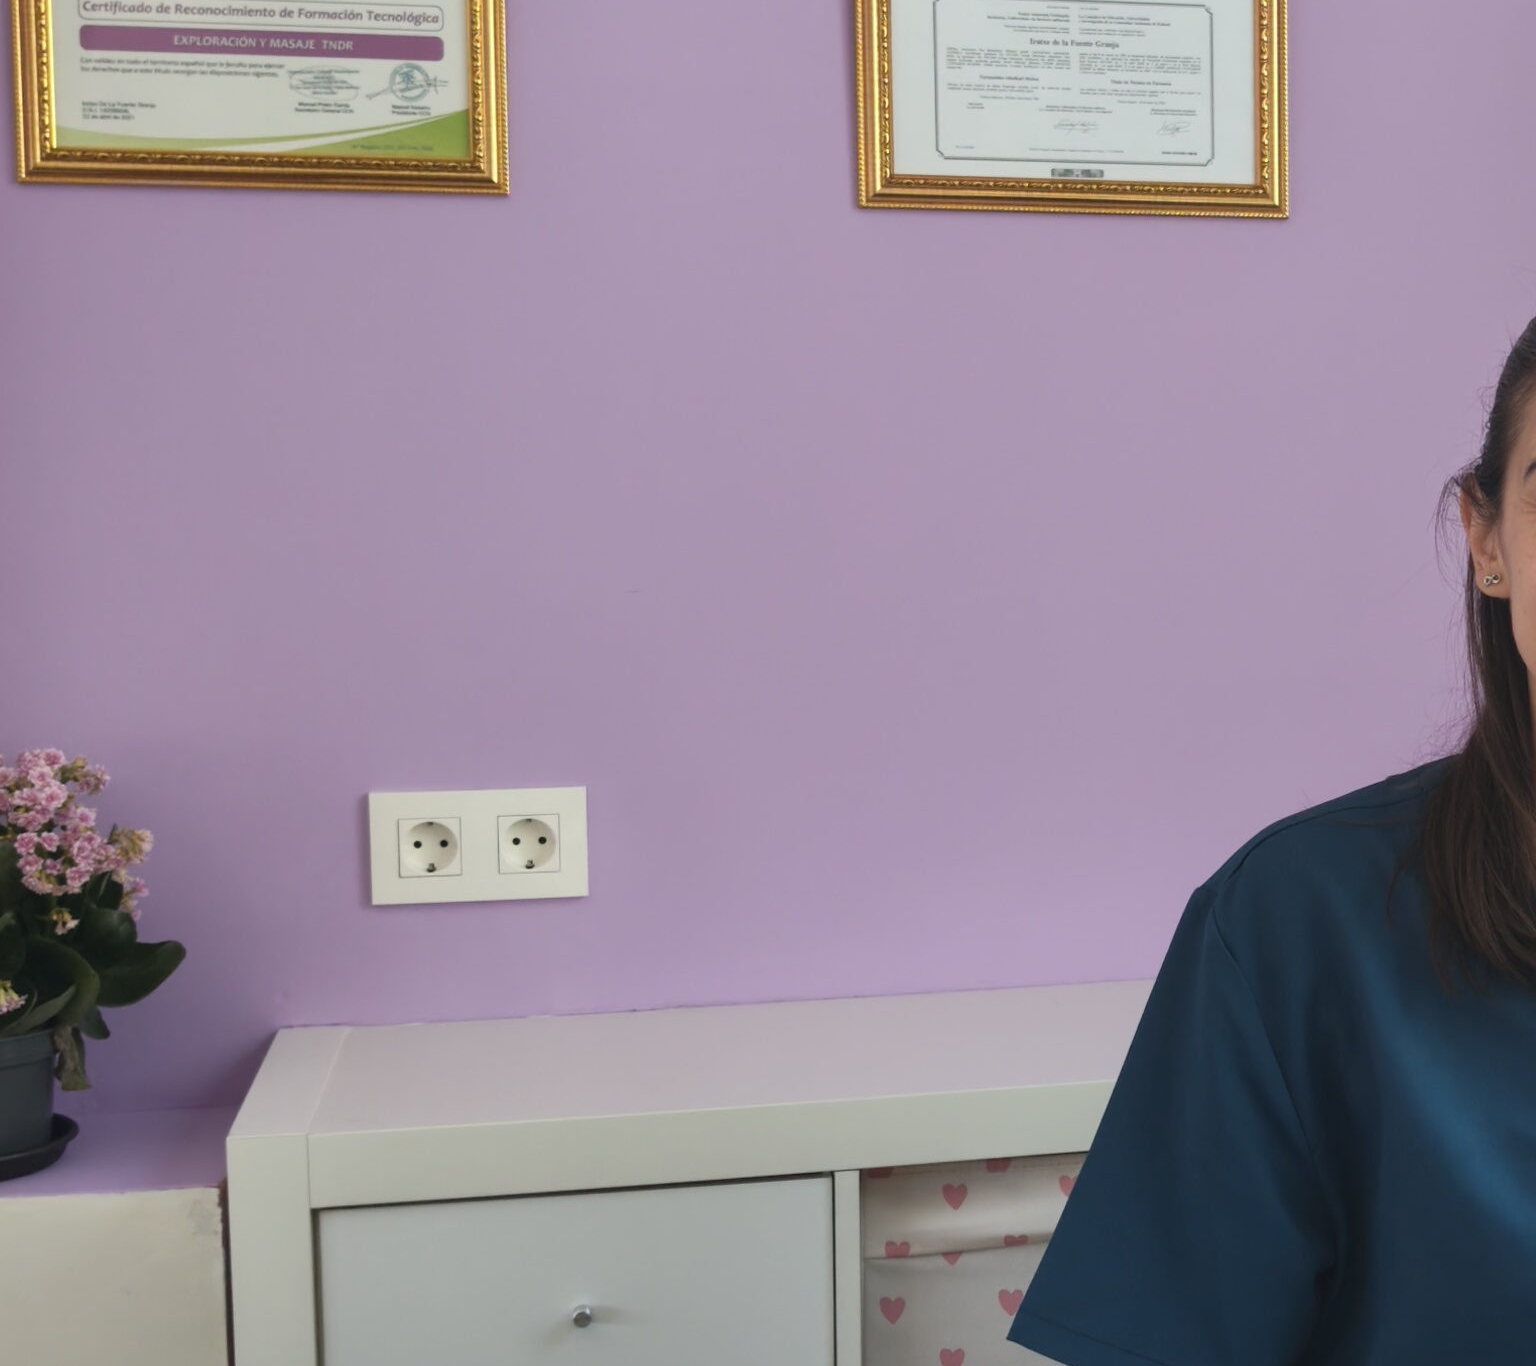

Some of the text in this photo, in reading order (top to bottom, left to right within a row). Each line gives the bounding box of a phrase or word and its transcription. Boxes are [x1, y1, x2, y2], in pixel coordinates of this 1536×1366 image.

[82, 0, 439, 26] Certificado de Reconocimiento de Formación Tecnológica
[174, 35, 353, 50] EXPLORACIÓN Y MASAJE TNDR
[1052, 38, 1060, 46] de
[1062, 39, 1069, 47] la
[1071, 39, 1093, 47] Fuente
[1095, 40, 1119, 49] Granja
